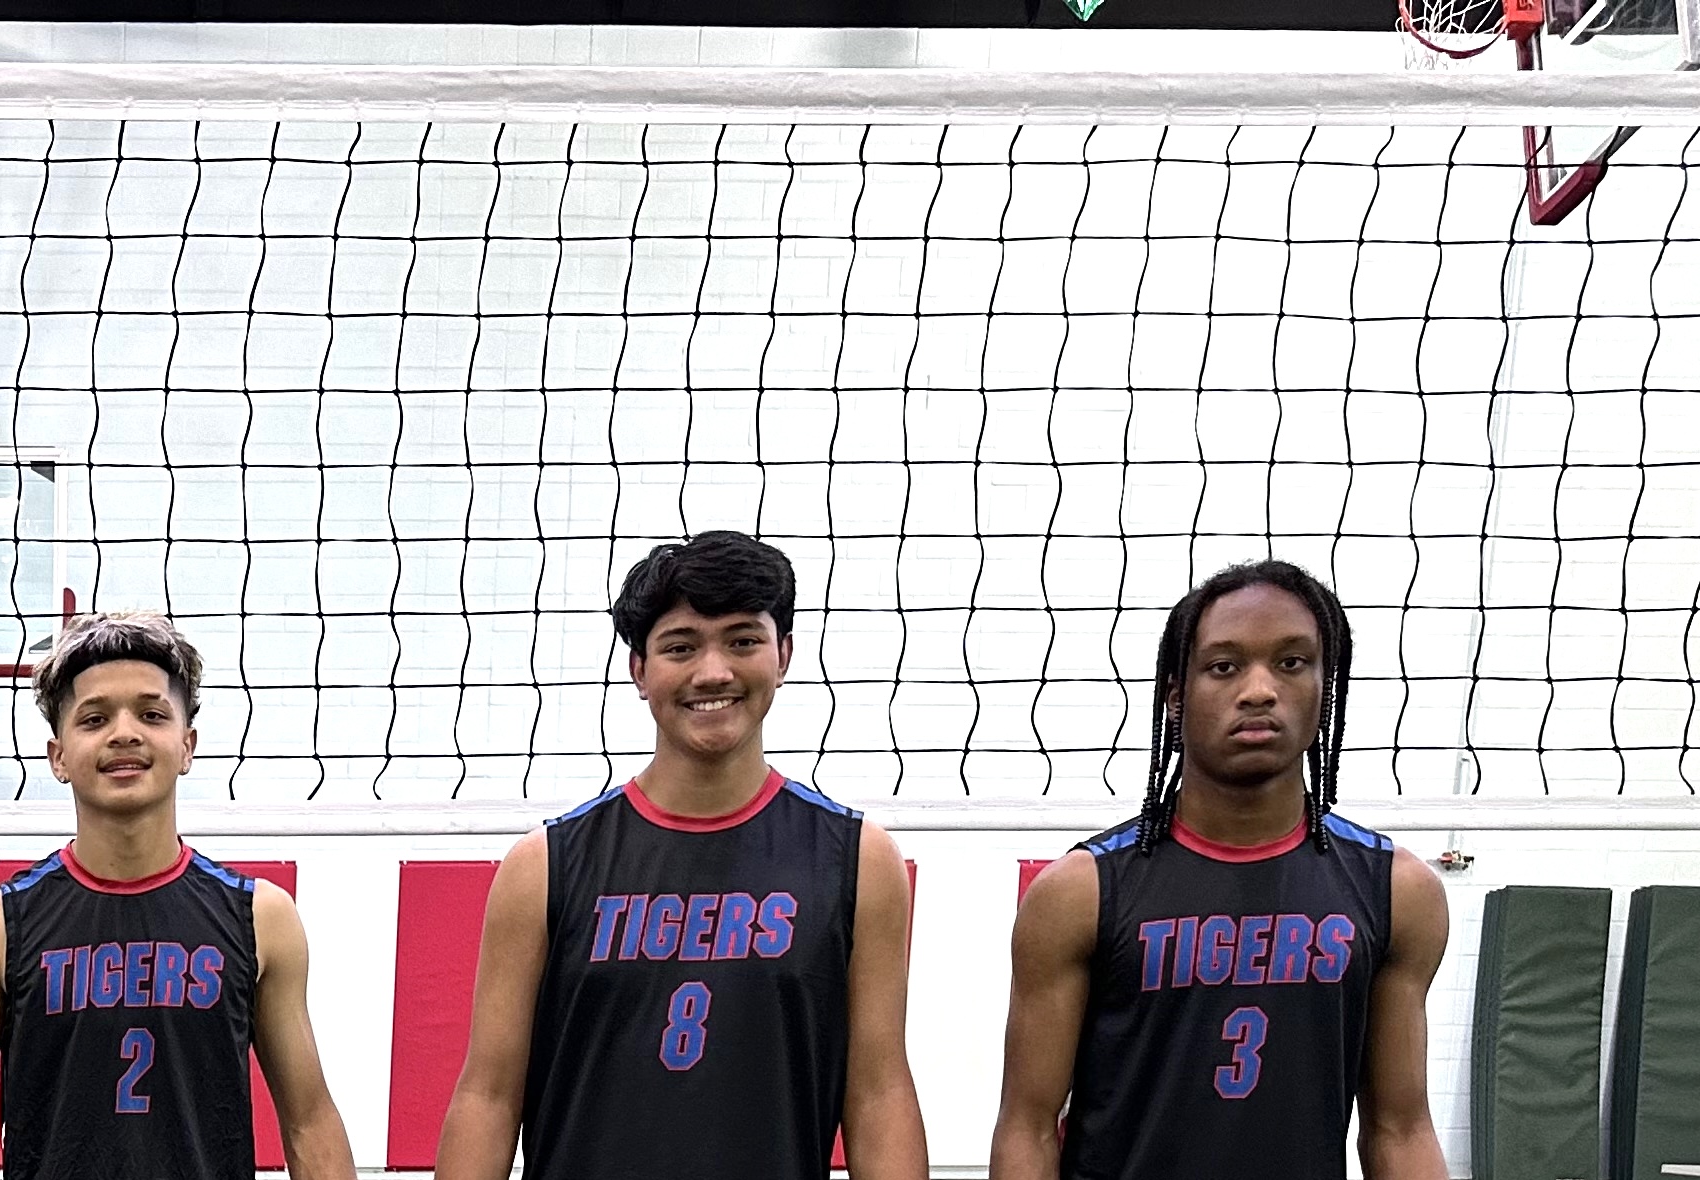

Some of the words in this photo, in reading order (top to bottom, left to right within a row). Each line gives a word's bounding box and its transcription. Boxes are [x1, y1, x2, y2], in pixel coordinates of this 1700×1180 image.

[589, 891, 799, 963] TIGERS
[1138, 913, 1356, 992] TIGERS
[40, 940, 225, 1016] TIGERS
[658, 981, 713, 1072] 8
[1213, 1005, 1270, 1100] 3
[114, 1027, 156, 1114] 2
